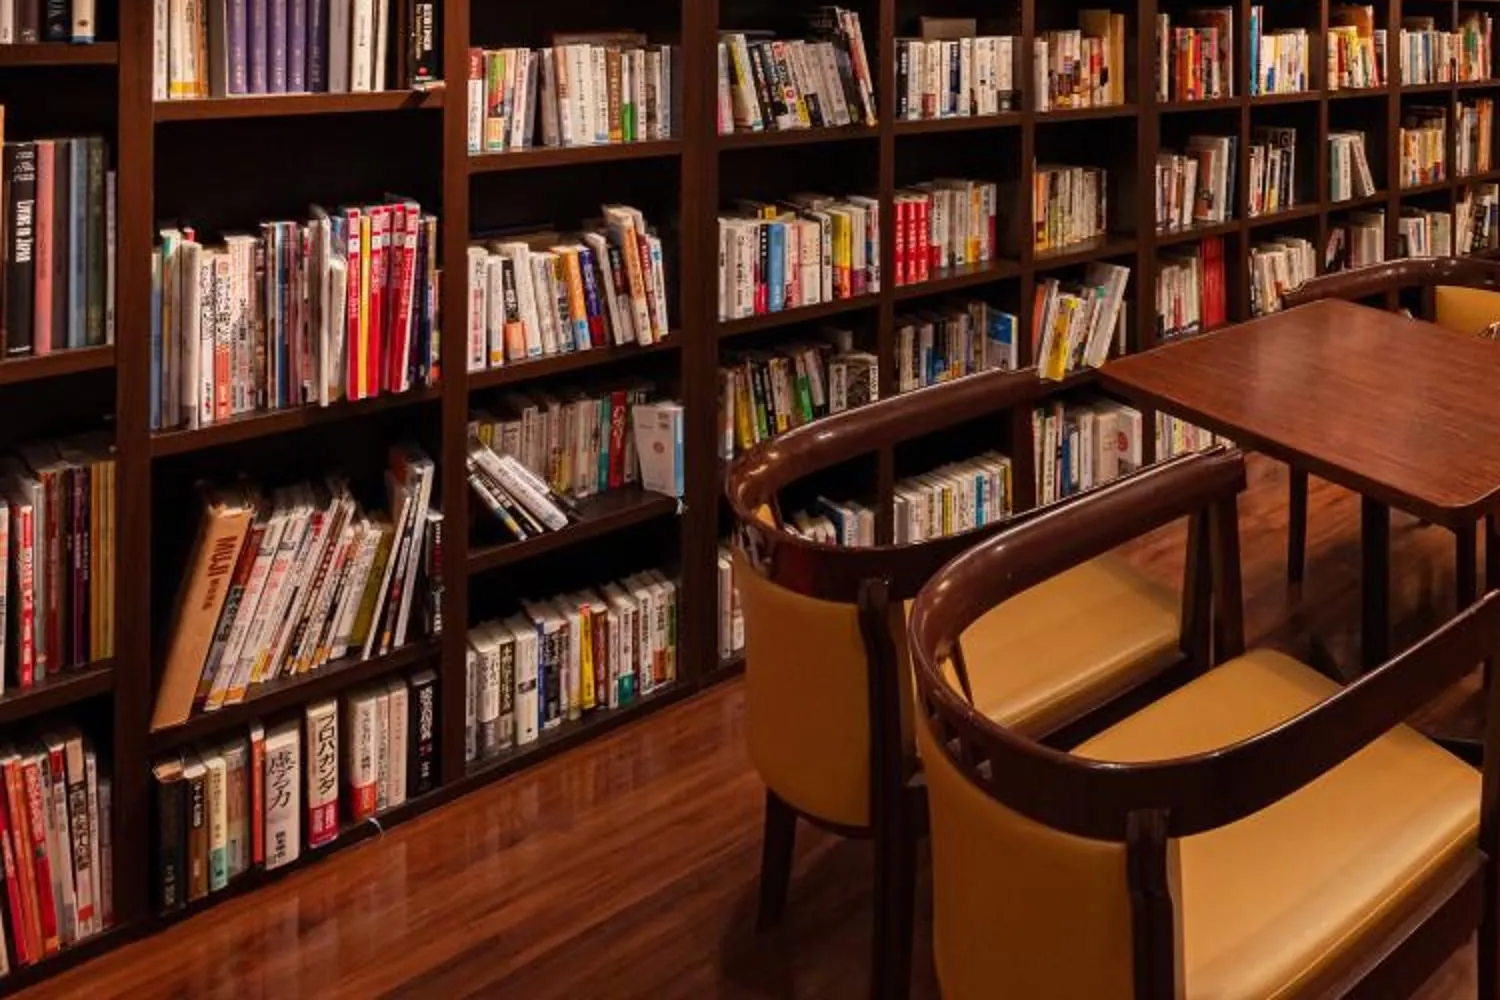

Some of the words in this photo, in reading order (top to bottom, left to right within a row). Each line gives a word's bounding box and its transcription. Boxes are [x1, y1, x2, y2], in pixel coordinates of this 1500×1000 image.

[317, 711, 335, 795] プロパガンダ
